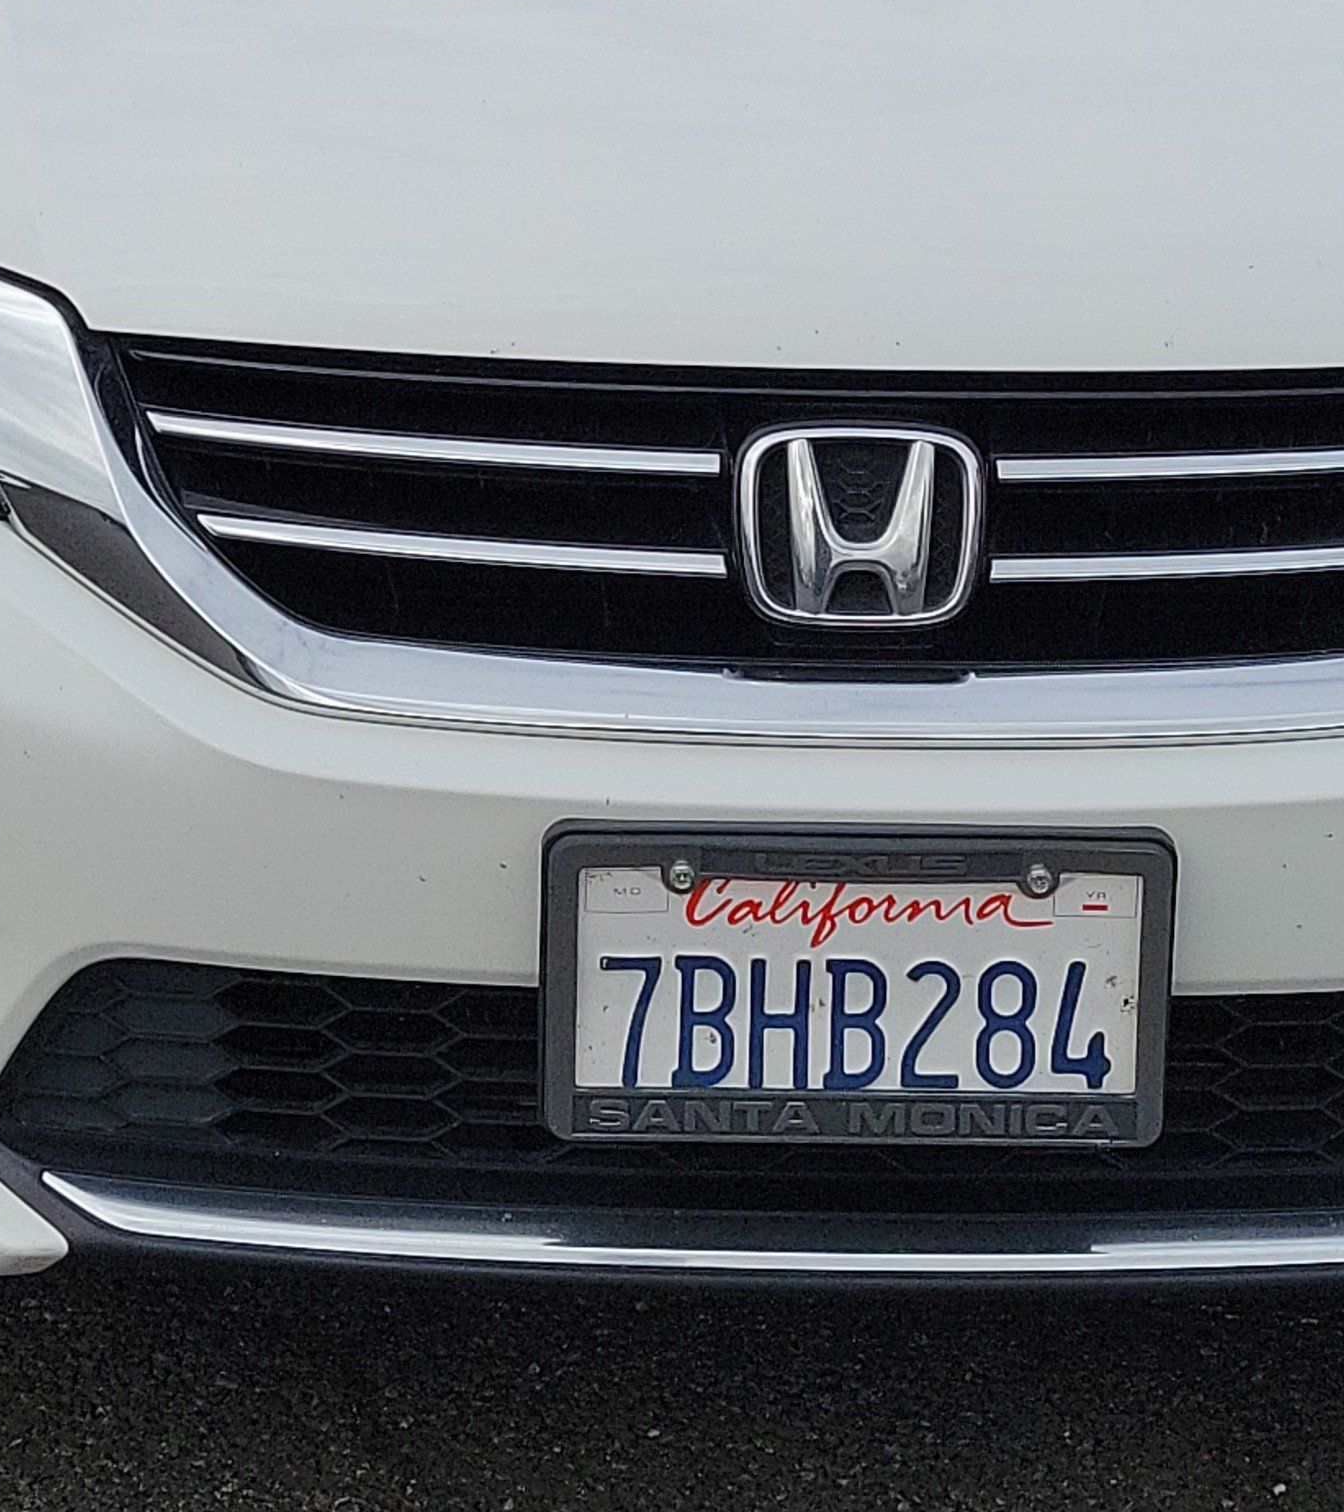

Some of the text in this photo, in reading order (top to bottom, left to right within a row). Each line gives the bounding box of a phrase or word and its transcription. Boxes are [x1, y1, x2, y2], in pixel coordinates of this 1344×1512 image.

[754, 854, 968, 877] LEXUS
[684, 877, 1054, 948] California
[599, 954, 1112, 1090] 7BHB284
[588, 1098, 1119, 1137] SANTA MONICA
